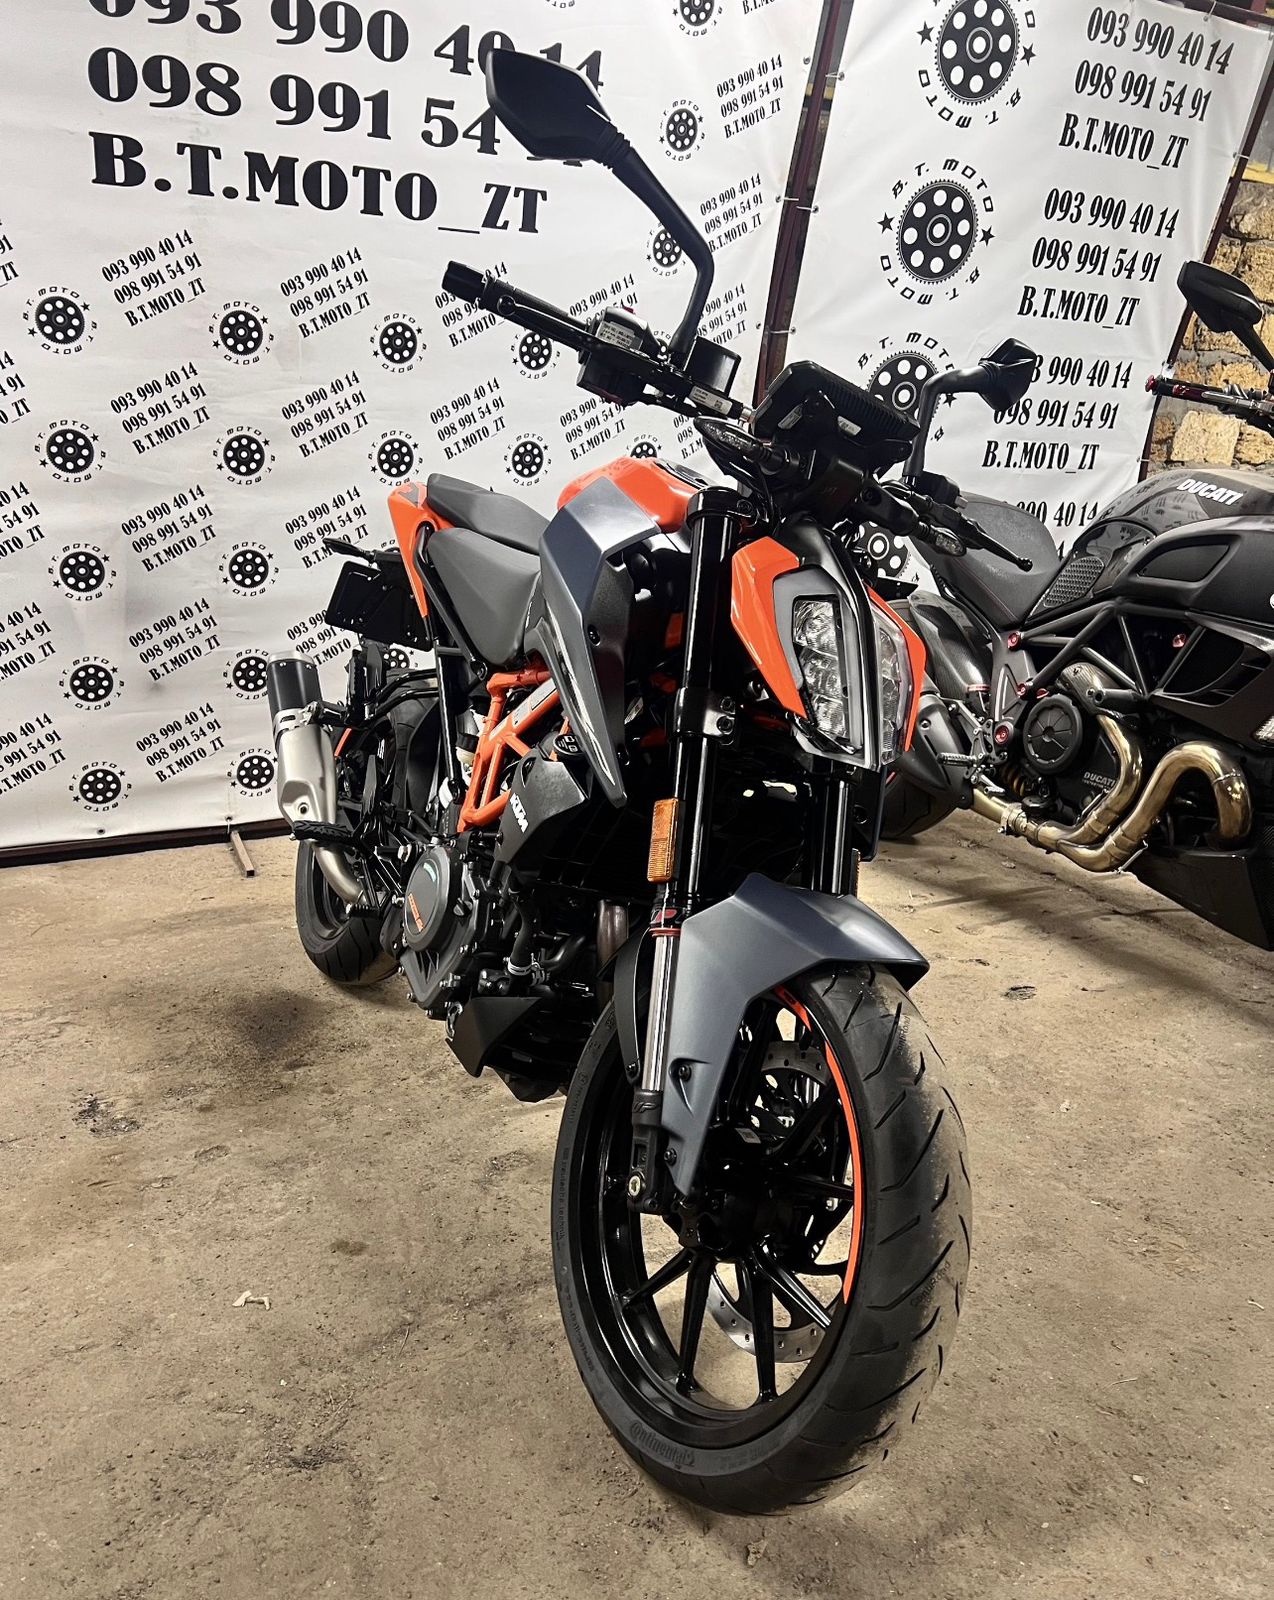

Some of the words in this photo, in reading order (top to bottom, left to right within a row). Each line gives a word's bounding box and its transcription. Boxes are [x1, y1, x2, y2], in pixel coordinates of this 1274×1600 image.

[270, 0, 409, 62] 990
[1087, 6, 1130, 48] 093
[1132, 18, 1175, 59] 990
[1177, 31, 1204, 67] 40
[1204, 39, 1234, 75] 14
[716, 78, 736, 98] 093
[738, 68, 755, 88] 990
[757, 61, 768, 77] 40
[770, 54, 782, 71] 14
[720, 98, 739, 118] 098
[741, 89, 757, 108] 991
[758, 81, 770, 98] 54
[772, 75, 784, 92] 91
[1075, 60, 1117, 100] 098
[1118, 70, 1157, 109] 991
[1159, 80, 1188, 116] 54
[1188, 87, 1212, 122] 91
[88, 47, 242, 116] 098
[270, 74, 392, 140] 991
[421, 98, 500, 155] 54
[724, 98, 781, 138] B.T.MOTO_ZT
[1058, 113, 1189, 170] B.T.MOTO_ZT
[88, 131, 548, 234] B.T.MOTO_ZT
[1044, 188, 1085, 224] 093
[1087, 196, 1126, 230] 990
[1129, 204, 1154, 234] 40
[1154, 208, 1180, 239] 14
[102, 259, 130, 282] 093
[129, 246, 156, 270] 990
[158, 238, 175, 256] 40
[175, 230, 194, 248] 14
[114, 281, 141, 304] 098
[140, 269, 166, 292] 991
[165, 260, 186, 280] 54
[184, 252, 202, 272] 91
[280, 275, 305, 297] 093
[304, 263, 329, 286] 990
[331, 254, 346, 272] 40
[346, 247, 362, 265] 14
[495, 262, 508, 278] 14
[1032, 236, 1073, 271] 098
[1074, 242, 1110, 276] 991
[1112, 248, 1139, 280] 54
[1139, 252, 1162, 282] 91
[124, 278, 206, 327] B.T.MOTO_ZT
[290, 295, 314, 317] 098
[314, 284, 336, 306] 991
[336, 275, 354, 294] 54
[353, 268, 368, 286] 91
[298, 291, 370, 338] B.T.MOTO_ZT
[569, 299, 589, 317] 093
[589, 288, 608, 308] 990
[610, 280, 622, 296] 40
[623, 274, 634, 289] 14
[1017, 285, 1140, 329] B.T.MOTO_ZT
[442, 308, 463, 327] 098
[6, 373, 26, 392] 91
[110, 392, 137, 414] 093
[136, 379, 162, 402] 990
[165, 370, 181, 388] 40
[180, 362, 198, 380] 14
[281, 399, 305, 420] 093
[305, 387, 328, 408] 990
[330, 378, 344, 395] 40
[344, 370, 360, 388] 14
[1046, 356, 1083, 386] 990
[1086, 359, 1110, 388] 40
[1111, 361, 1133, 389] 14
[122, 412, 148, 434] 098
[148, 400, 172, 422] 991
[171, 391, 191, 410] 54
[190, 384, 207, 401] 91
[290, 418, 314, 438] 098
[314, 406, 336, 427] 991
[335, 398, 352, 416] 54
[352, 390, 366, 407] 91
[430, 405, 451, 424] 093
[451, 393, 471, 413] 990
[474, 385, 486, 400] 40
[487, 378, 500, 393] 14
[437, 422, 458, 442] 098
[458, 412, 477, 430] 991
[477, 404, 492, 420] 54
[492, 398, 505, 418] 91
[1036, 400, 1070, 428] 991
[1072, 401, 1097, 428] 54
[1098, 402, 1120, 429] 91
[132, 406, 210, 454] B.T.MOTO_ZT
[298, 411, 368, 458] B.T.MOTO_ZT
[444, 416, 506, 460] B.T.MOTO_ZT
[981, 440, 1100, 474] B.T.MOTO_ZT
[11, 481, 30, 499] 14
[121, 515, 147, 536] 093
[146, 502, 171, 524] 990
[173, 493, 188, 510] 40
[188, 485, 205, 501] 14
[285, 514, 308, 534] 093
[308, 502, 330, 523] 990
[332, 494, 346, 510] 40
[346, 486, 361, 502] 14
[1176, 478, 1244, 506] DUCATI
[2, 510, 23, 528] 54
[22, 501, 40, 519] 91
[132, 532, 157, 554] 098
[156, 520, 180, 542] 991
[179, 511, 198, 529] 54
[197, 504, 214, 520] 91
[294, 532, 316, 551] 098
[316, 520, 337, 541] 991
[337, 511, 353, 528] 54
[352, 504, 367, 520] 91
[1053, 502, 1076, 527] 40
[141, 524, 216, 572] B.T.MOTO_ZT
[7, 611, 24, 627] 40
[24, 602, 42, 619] 14
[15, 628, 35, 646] 54
[33, 620, 52, 637] 91
[128, 628, 154, 648] 093
[152, 615, 177, 636] 990
[179, 606, 194, 622] 40
[194, 598, 210, 614] 14
[287, 622, 309, 640] 093
[139, 644, 164, 664] 098
[162, 632, 186, 652] 991
[184, 622, 203, 640] 54
[202, 615, 218, 631] 91
[148, 634, 220, 682] B.T.MOTO_ZT
[4, 748, 28, 768] 991
[27, 738, 46, 755] 54
[45, 729, 62, 746] 91
[20, 722, 36, 738] 40
[35, 713, 52, 729] 14
[136, 733, 160, 752] 093
[159, 720, 183, 740] 990
[184, 711, 199, 726] 40
[199, 702, 214, 718] 14
[146, 747, 170, 766] 098
[168, 735, 191, 754] 991
[190, 726, 208, 742] 54
[206, 718, 222, 733] 91
[155, 736, 225, 783] B.T.MOTO_ZT
[1084, 771, 1115, 787] DUCATI
[510, 792, 529, 833] KTM
